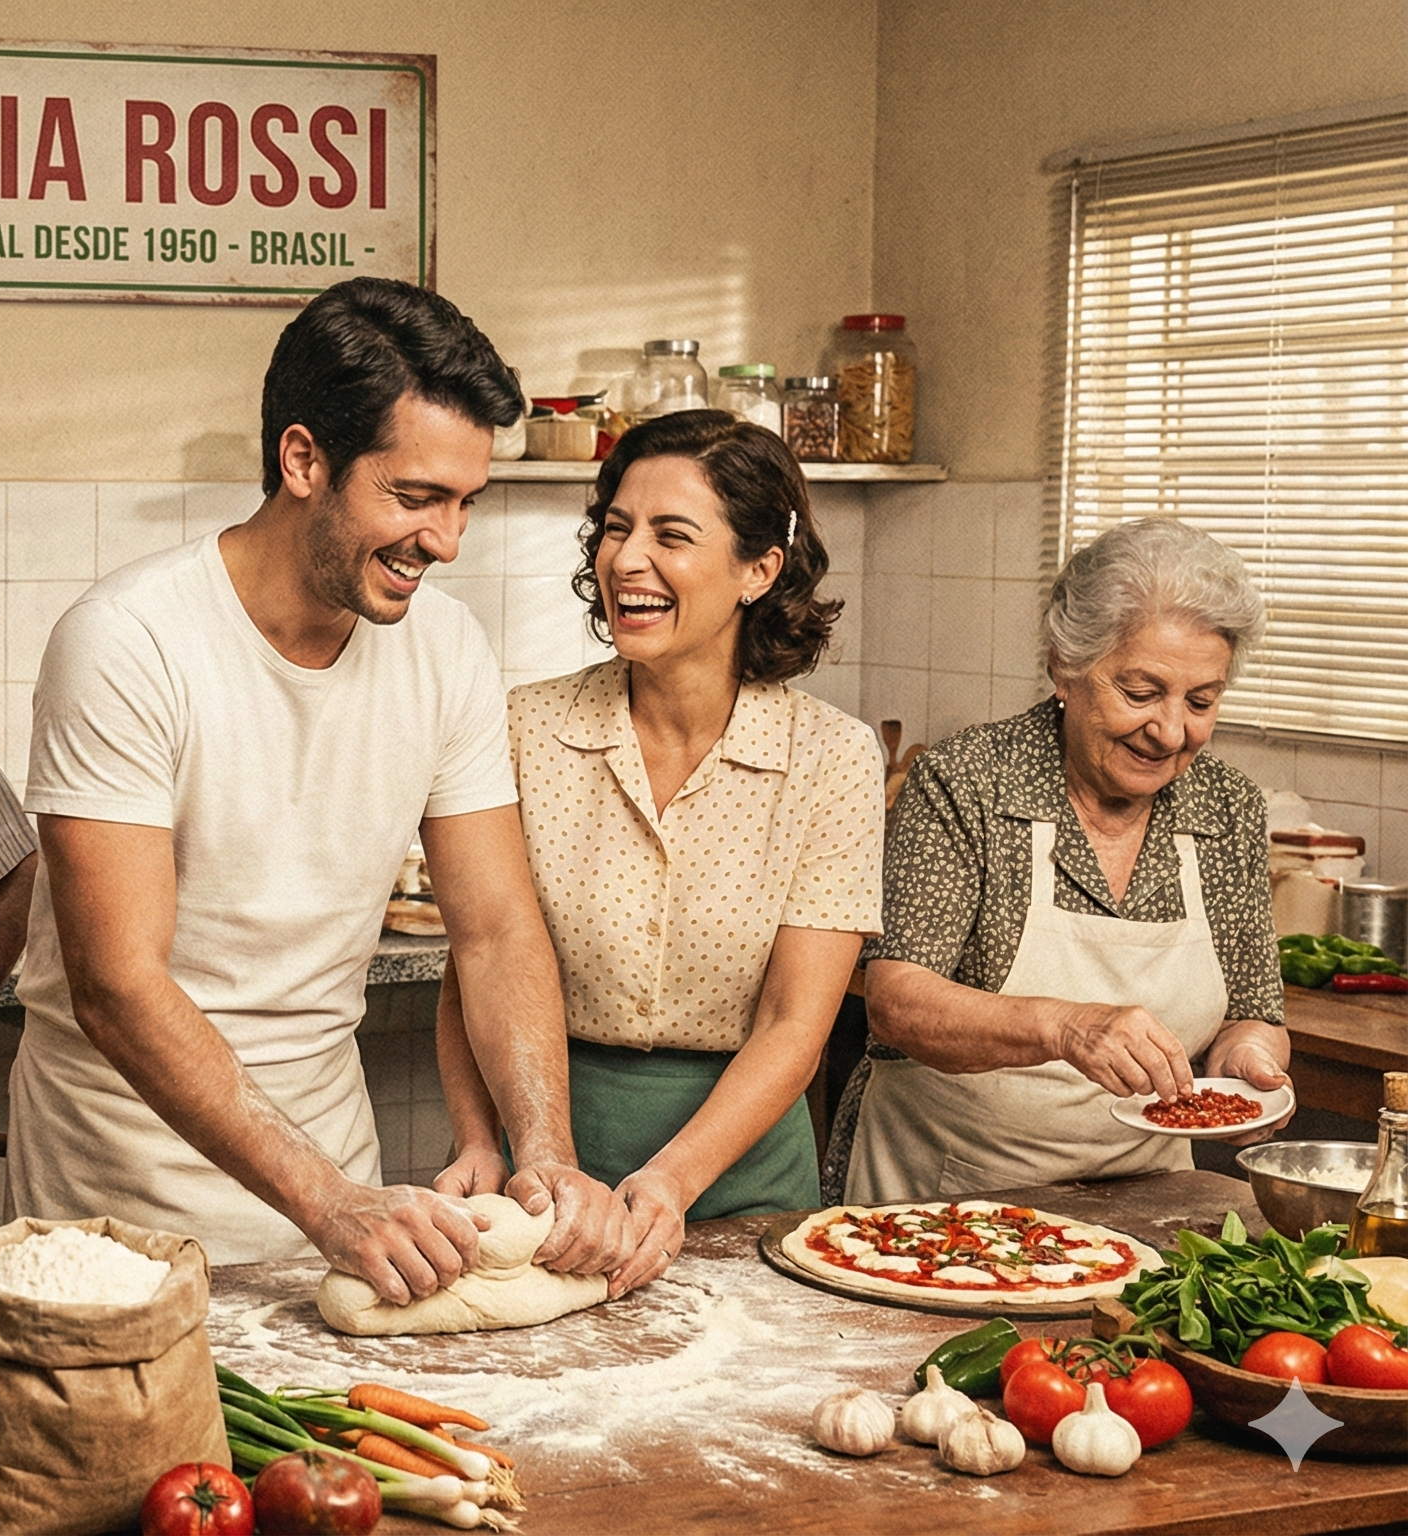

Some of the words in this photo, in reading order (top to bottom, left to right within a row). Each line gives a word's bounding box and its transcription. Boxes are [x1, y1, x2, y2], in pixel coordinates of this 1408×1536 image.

[124, 99, 387, 210] ROSSI
[33, 224, 130, 261] DESDE
[143, 227, 218, 264] 1950
[249, 230, 356, 267] BRASIL
